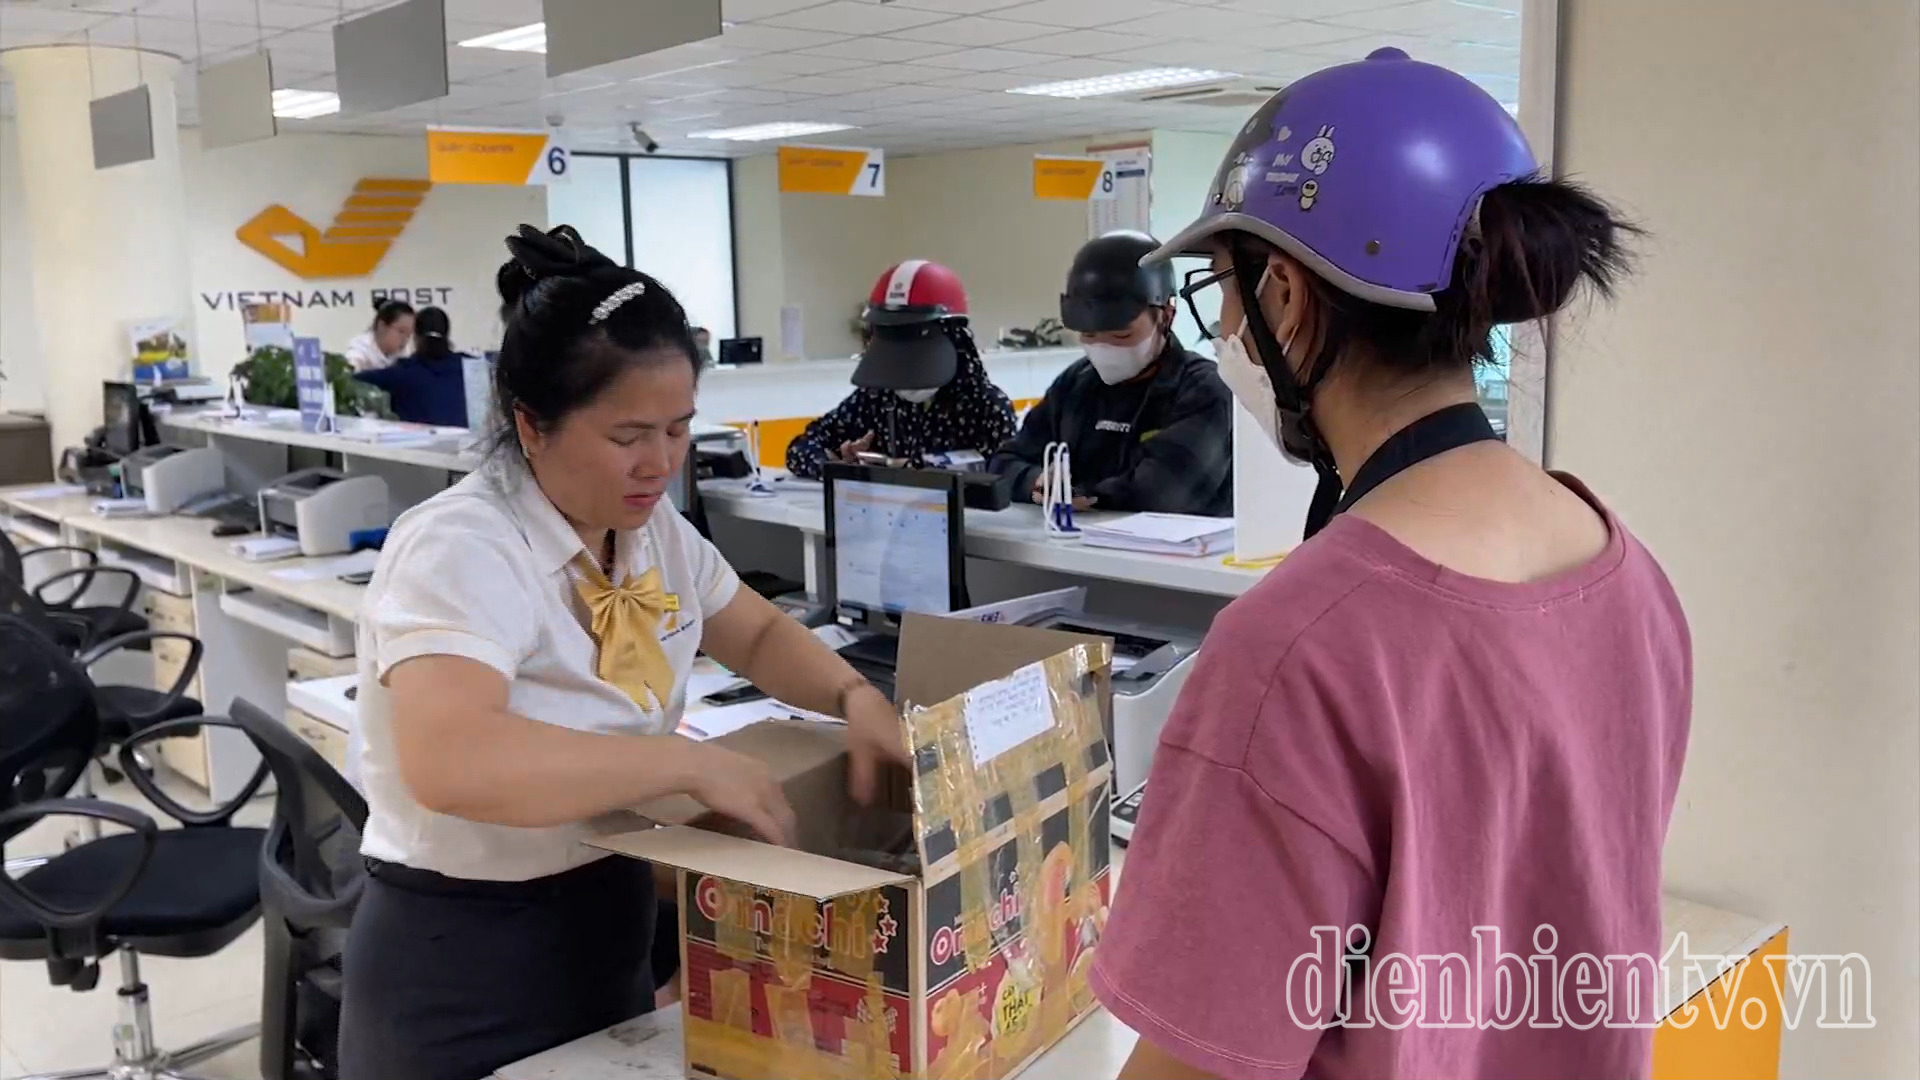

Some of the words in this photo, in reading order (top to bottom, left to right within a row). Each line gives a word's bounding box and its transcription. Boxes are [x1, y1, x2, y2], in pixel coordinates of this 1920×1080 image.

[547, 146, 567, 176] 6
[867, 163, 880, 188] 7
[1102, 170, 1114, 193] 8
[201, 290, 355, 312] VIETNAM
[370, 287, 453, 306] POST
[930, 880, 1028, 966] Omchi
